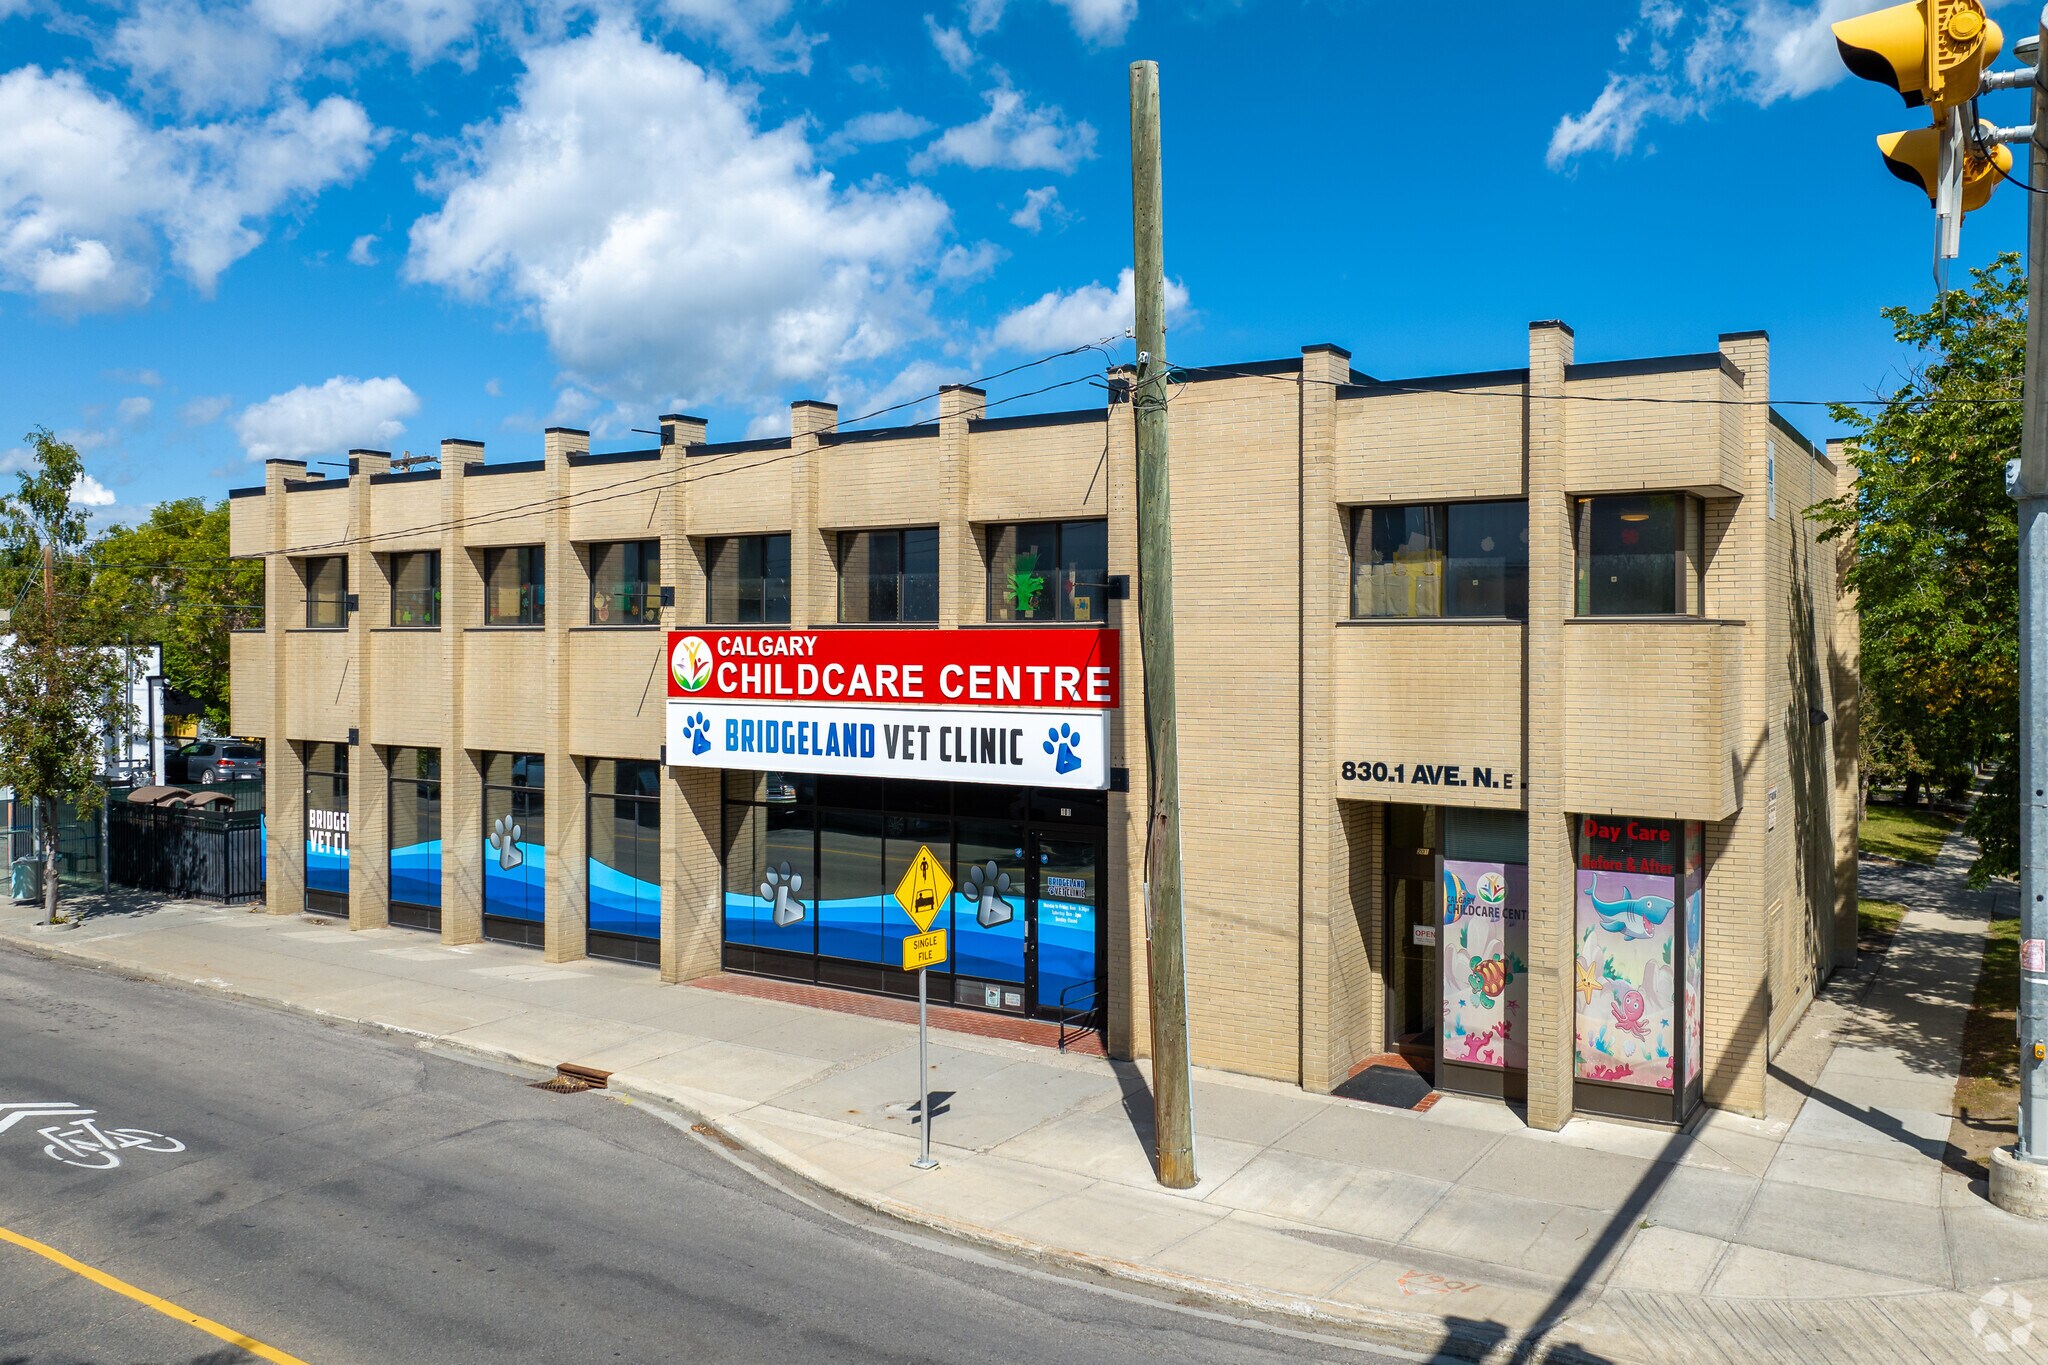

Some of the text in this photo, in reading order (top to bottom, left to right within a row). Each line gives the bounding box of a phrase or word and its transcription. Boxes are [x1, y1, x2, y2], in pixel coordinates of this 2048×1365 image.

[717, 635, 818, 657] CALGARY
[717, 661, 1112, 702] CHILDCARE CENTRE
[725, 718, 1024, 765] BRIDGELAND VET CLINIC
[1410, 764, 1467, 787] AVE.
[1583, 819, 1622, 843] Day
[1626, 821, 1671, 842] Care
[309, 829, 332, 854] VET
[1581, 853, 1622, 871] Before
[1625, 857, 1637, 873] &
[1639, 858, 1674, 875] After
[1048, 877, 1086, 889] BRIDGELAND
[1055, 887, 1086, 898] VET CLINIC
[1446, 895, 1476, 905] CALGARY
[1447, 903, 1527, 921] CHILDCARE CENT
[913, 935, 938, 950] SINGLE
[1415, 929, 1436, 938] OPEN
[918, 949, 933, 962] FILE
